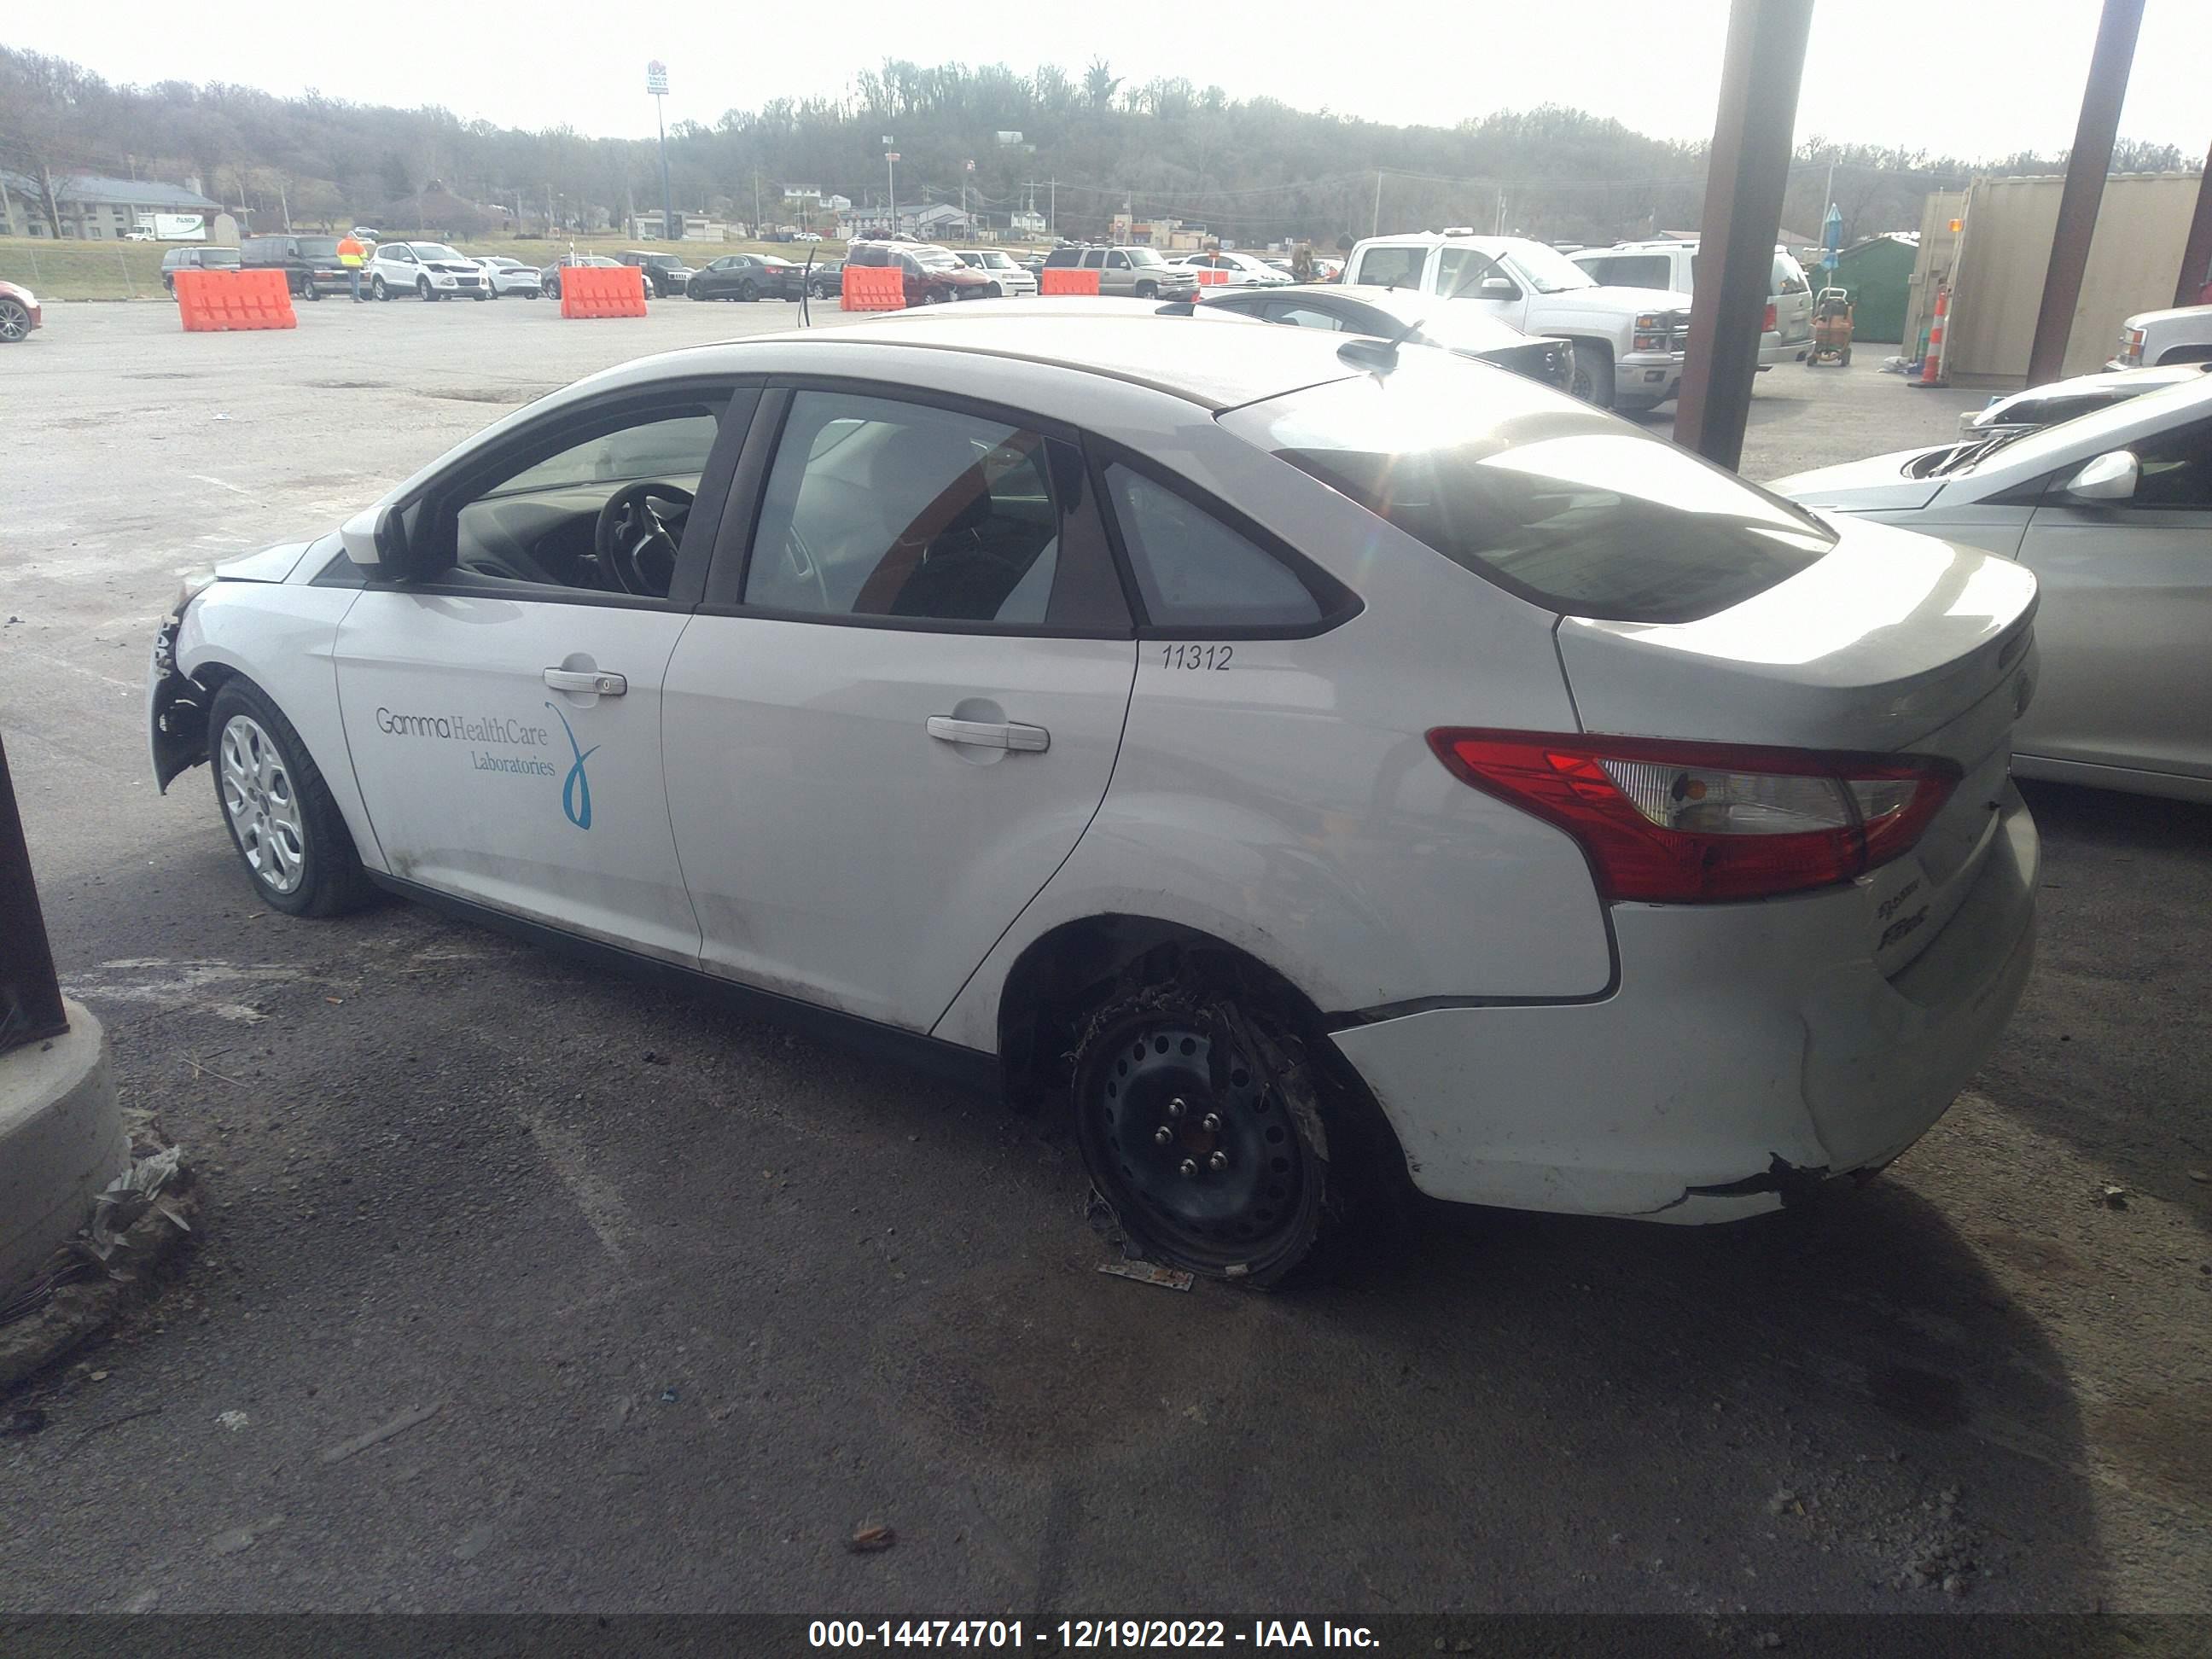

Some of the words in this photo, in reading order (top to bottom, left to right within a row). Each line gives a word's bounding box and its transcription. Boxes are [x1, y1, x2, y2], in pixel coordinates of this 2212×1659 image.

[1162, 644, 1234, 671] 11312
[375, 707, 451, 739] Gamma
[451, 715, 549, 746] HealthCare
[470, 750, 556, 777] Laboratories
